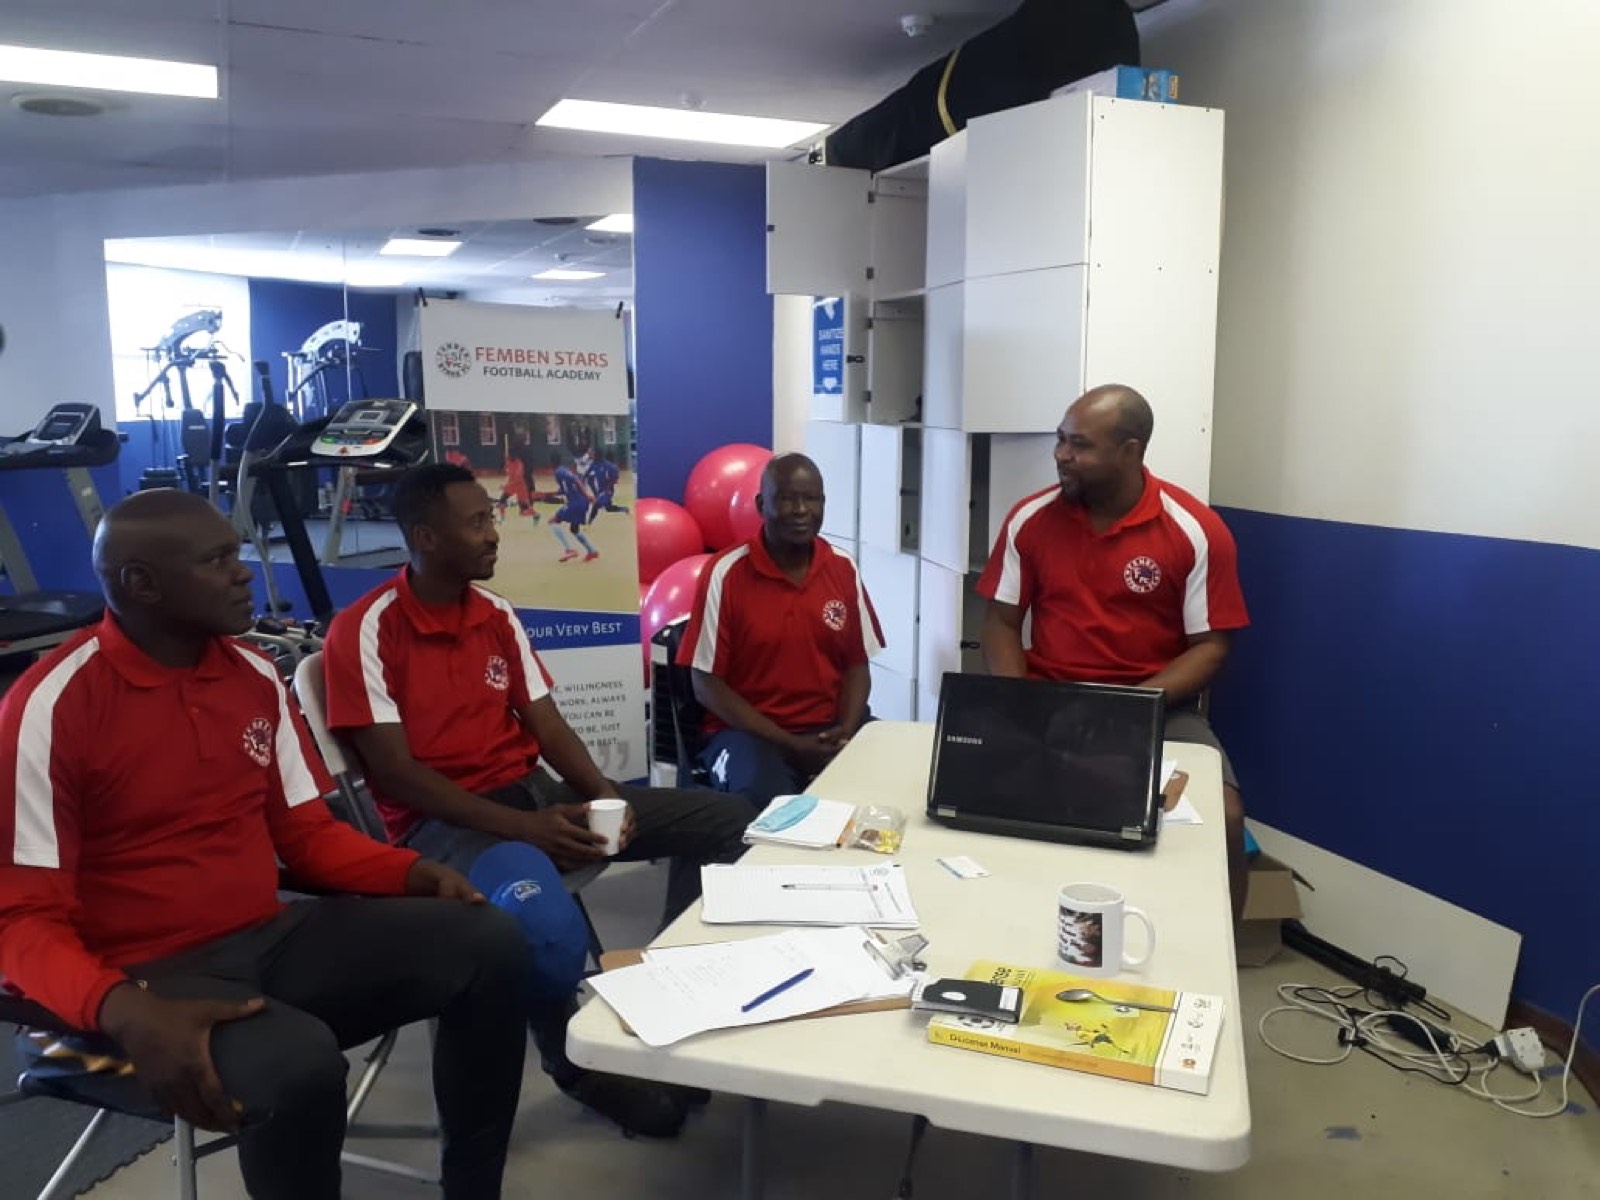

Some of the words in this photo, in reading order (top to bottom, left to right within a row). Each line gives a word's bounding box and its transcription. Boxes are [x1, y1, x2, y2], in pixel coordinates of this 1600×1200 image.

[475, 346, 549, 364] FEMBEN
[555, 351, 609, 368] STARS
[483, 366, 543, 378] FOOTBALL
[546, 370, 602, 381] ACADEMY
[565, 682, 624, 692] WILLINGNESS
